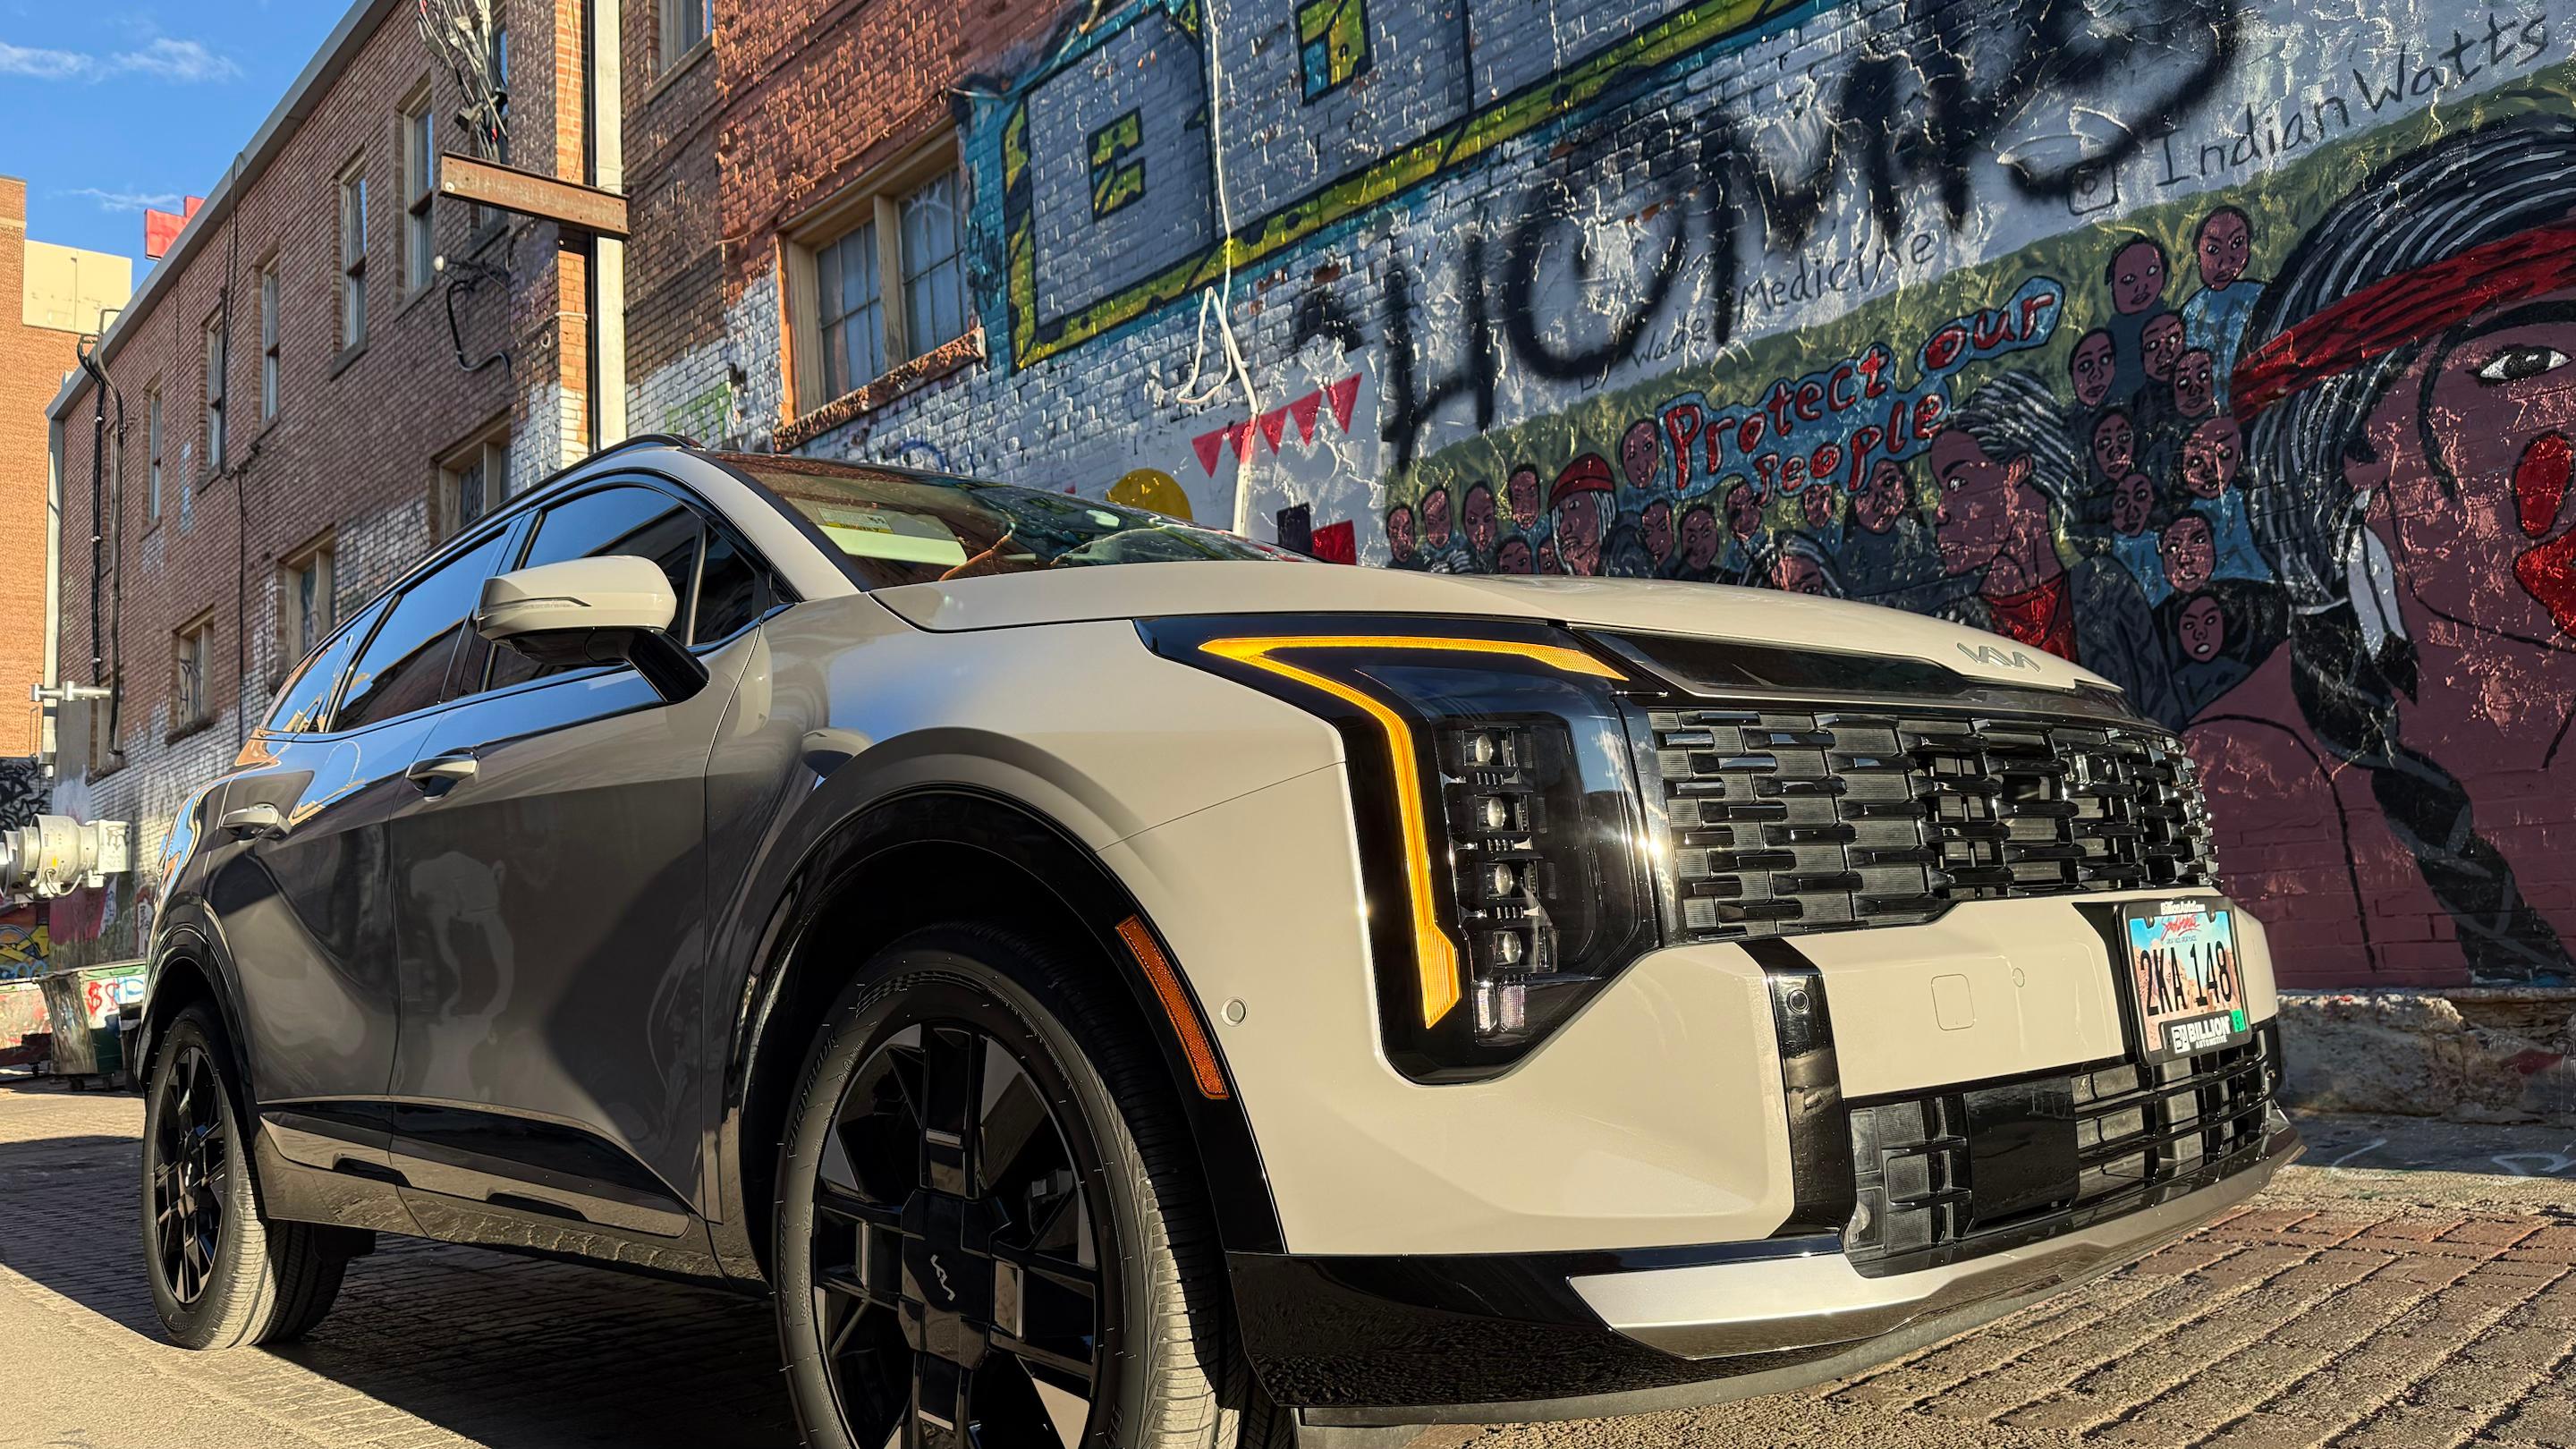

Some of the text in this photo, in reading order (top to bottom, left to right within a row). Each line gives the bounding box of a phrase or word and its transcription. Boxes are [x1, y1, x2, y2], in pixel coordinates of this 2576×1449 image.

[1736, 233, 1936, 325] Medicine
[1665, 292, 2055, 491] Protect our
[2140, 940, 2232, 1017] 2KA 148
[2186, 1015, 2232, 1043] BILLION
